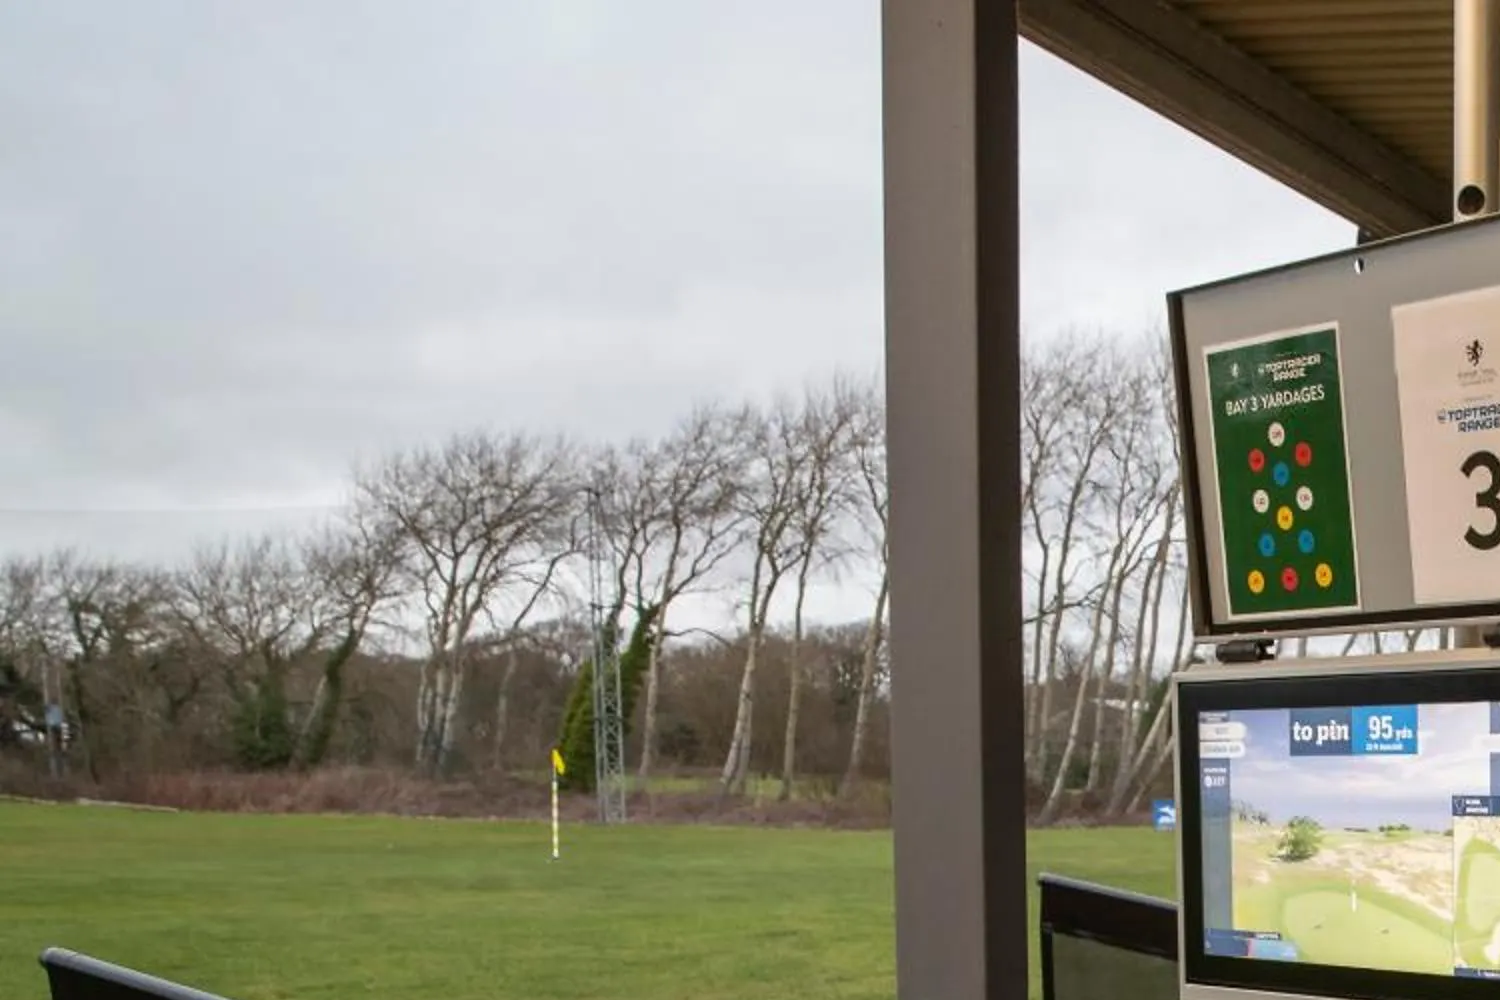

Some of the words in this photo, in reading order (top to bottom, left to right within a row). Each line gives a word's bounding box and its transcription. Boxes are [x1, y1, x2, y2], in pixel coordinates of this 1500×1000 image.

[1225, 398, 1248, 416] BAY
[1250, 395, 1259, 412] 3
[1261, 384, 1325, 409] YARDAGES
[1293, 720, 1313, 741] to
[1316, 719, 1349, 746] pin
[1368, 715, 1393, 740] 95
[1393, 724, 1413, 742] yds
